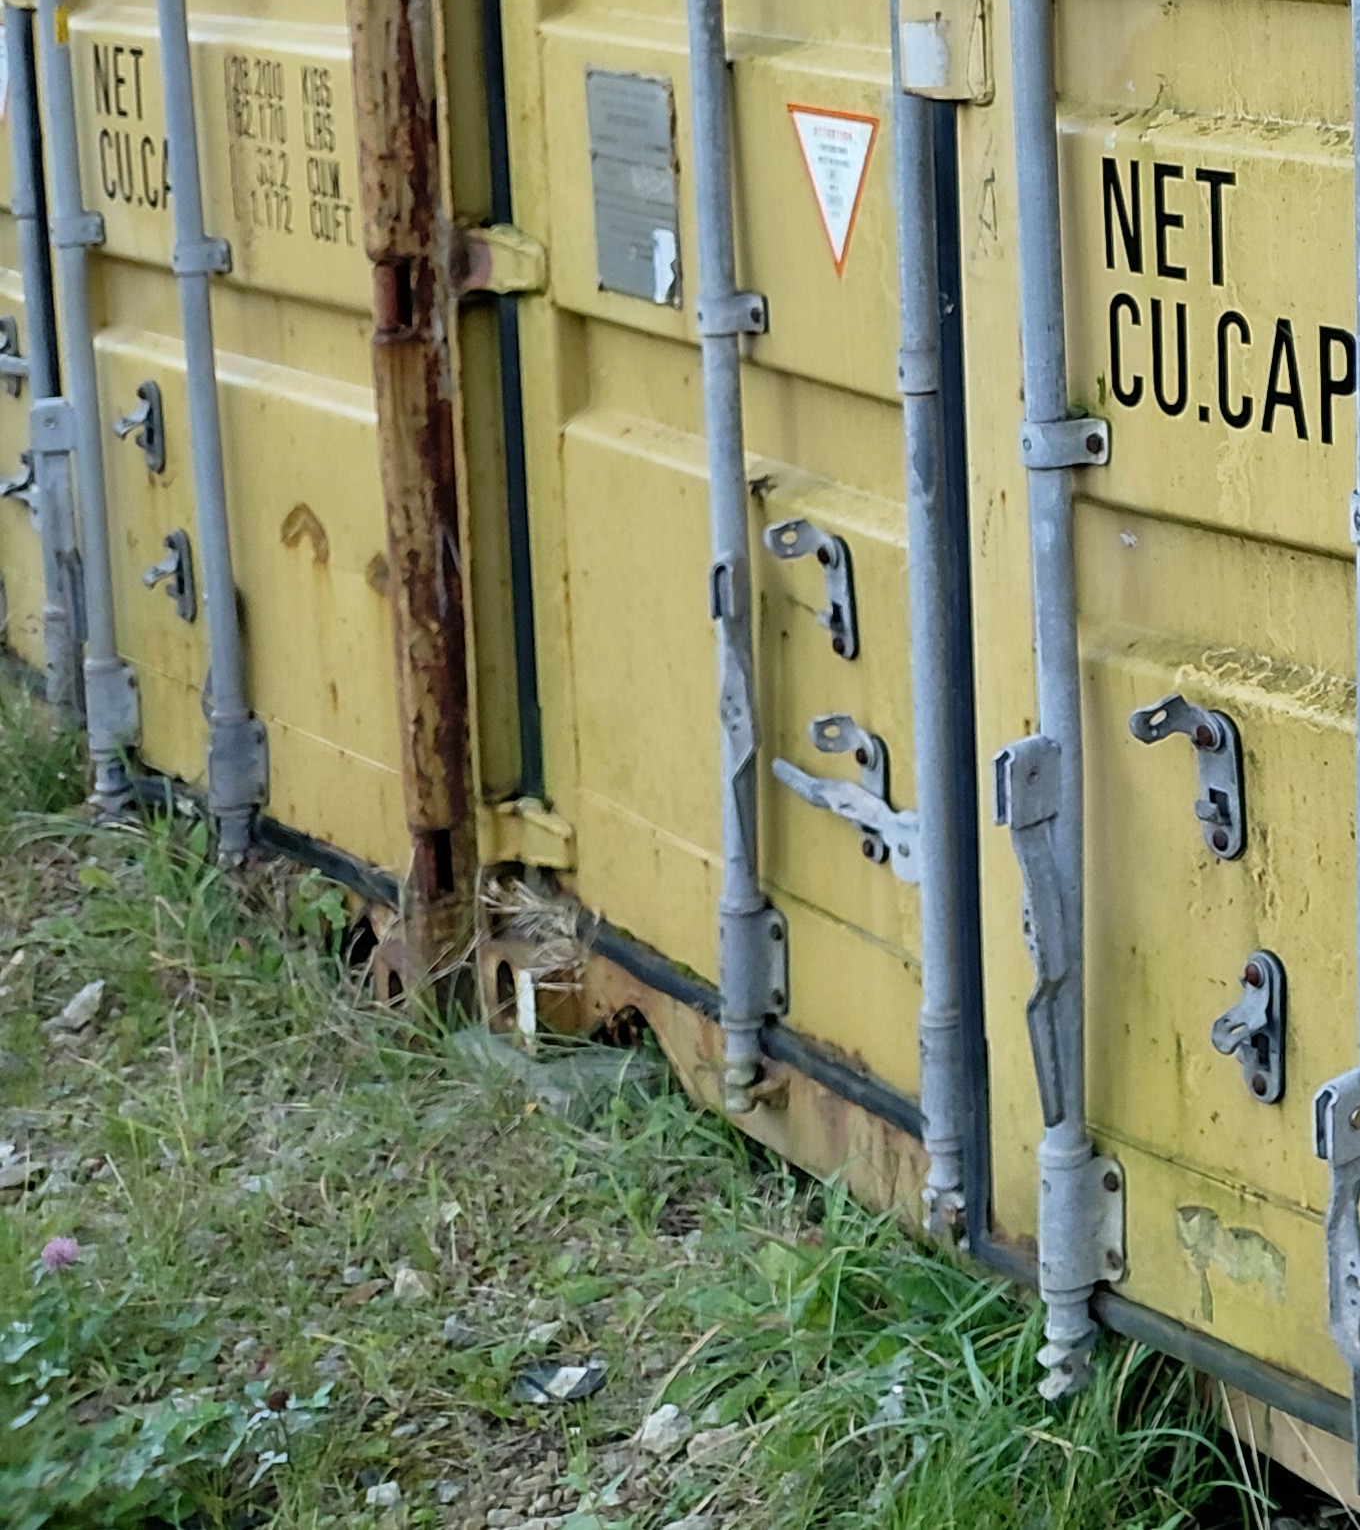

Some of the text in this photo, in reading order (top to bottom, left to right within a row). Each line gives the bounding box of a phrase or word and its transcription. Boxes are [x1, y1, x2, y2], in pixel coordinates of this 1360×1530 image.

[93, 42, 145, 121] NET
[1102, 156, 1237, 287] NET
[1108, 292, 1358, 446] CU.CAP
